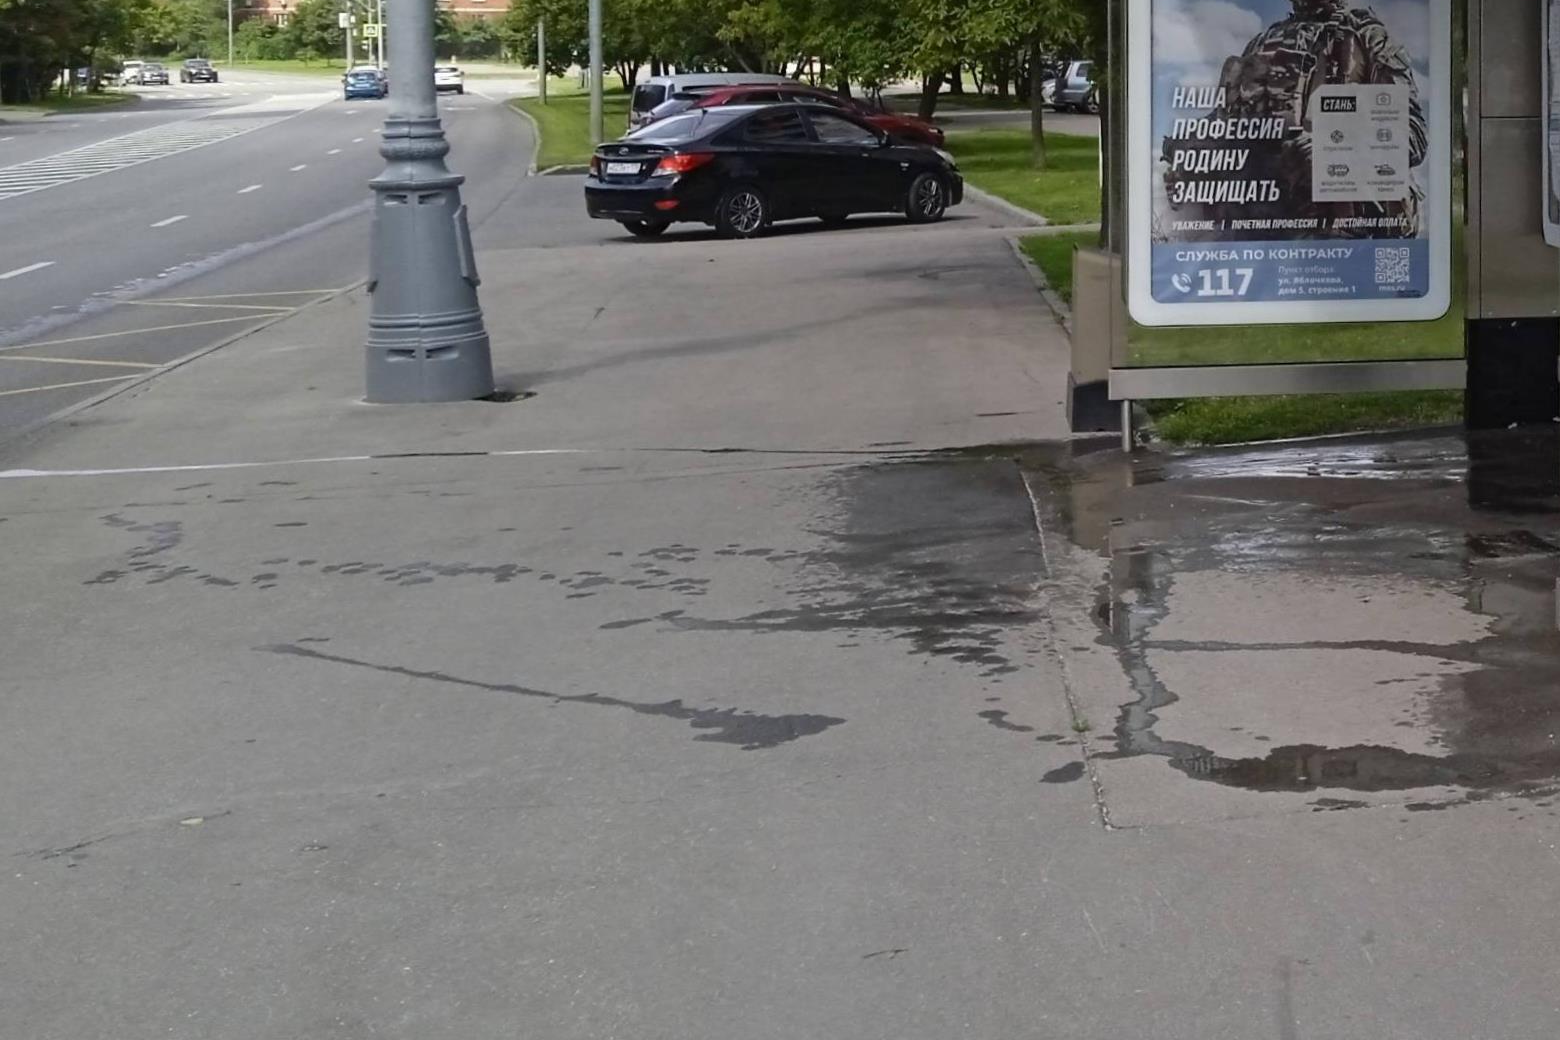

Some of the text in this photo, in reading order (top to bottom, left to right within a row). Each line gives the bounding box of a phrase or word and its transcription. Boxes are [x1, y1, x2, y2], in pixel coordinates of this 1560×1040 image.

[1172, 86, 1227, 109] НАША
[1323, 98, 1356, 112] СТАНЬ:
[1172, 117, 1286, 140] ПРОФЕССИЯ
[1172, 148, 1250, 174] РОДИНУ
[1172, 179, 1281, 205] ЗАЩИЩАТЬ
[1172, 220, 1215, 231] УВАЖЕНИЕ
[1231, 218, 1319, 230] ПОЧЕТНАЯ ПРОФЕССИЯ
[1332, 217, 1408, 229] ДОСТОЙНАЯ ОПЛАТА
[1175, 247, 1354, 262] СЛУЖБА ПО КОНТРАКТУ
[1278, 265, 1302, 274] Пункт
[1197, 267, 1255, 297] 117
[1278, 287, 1297, 296] дом
